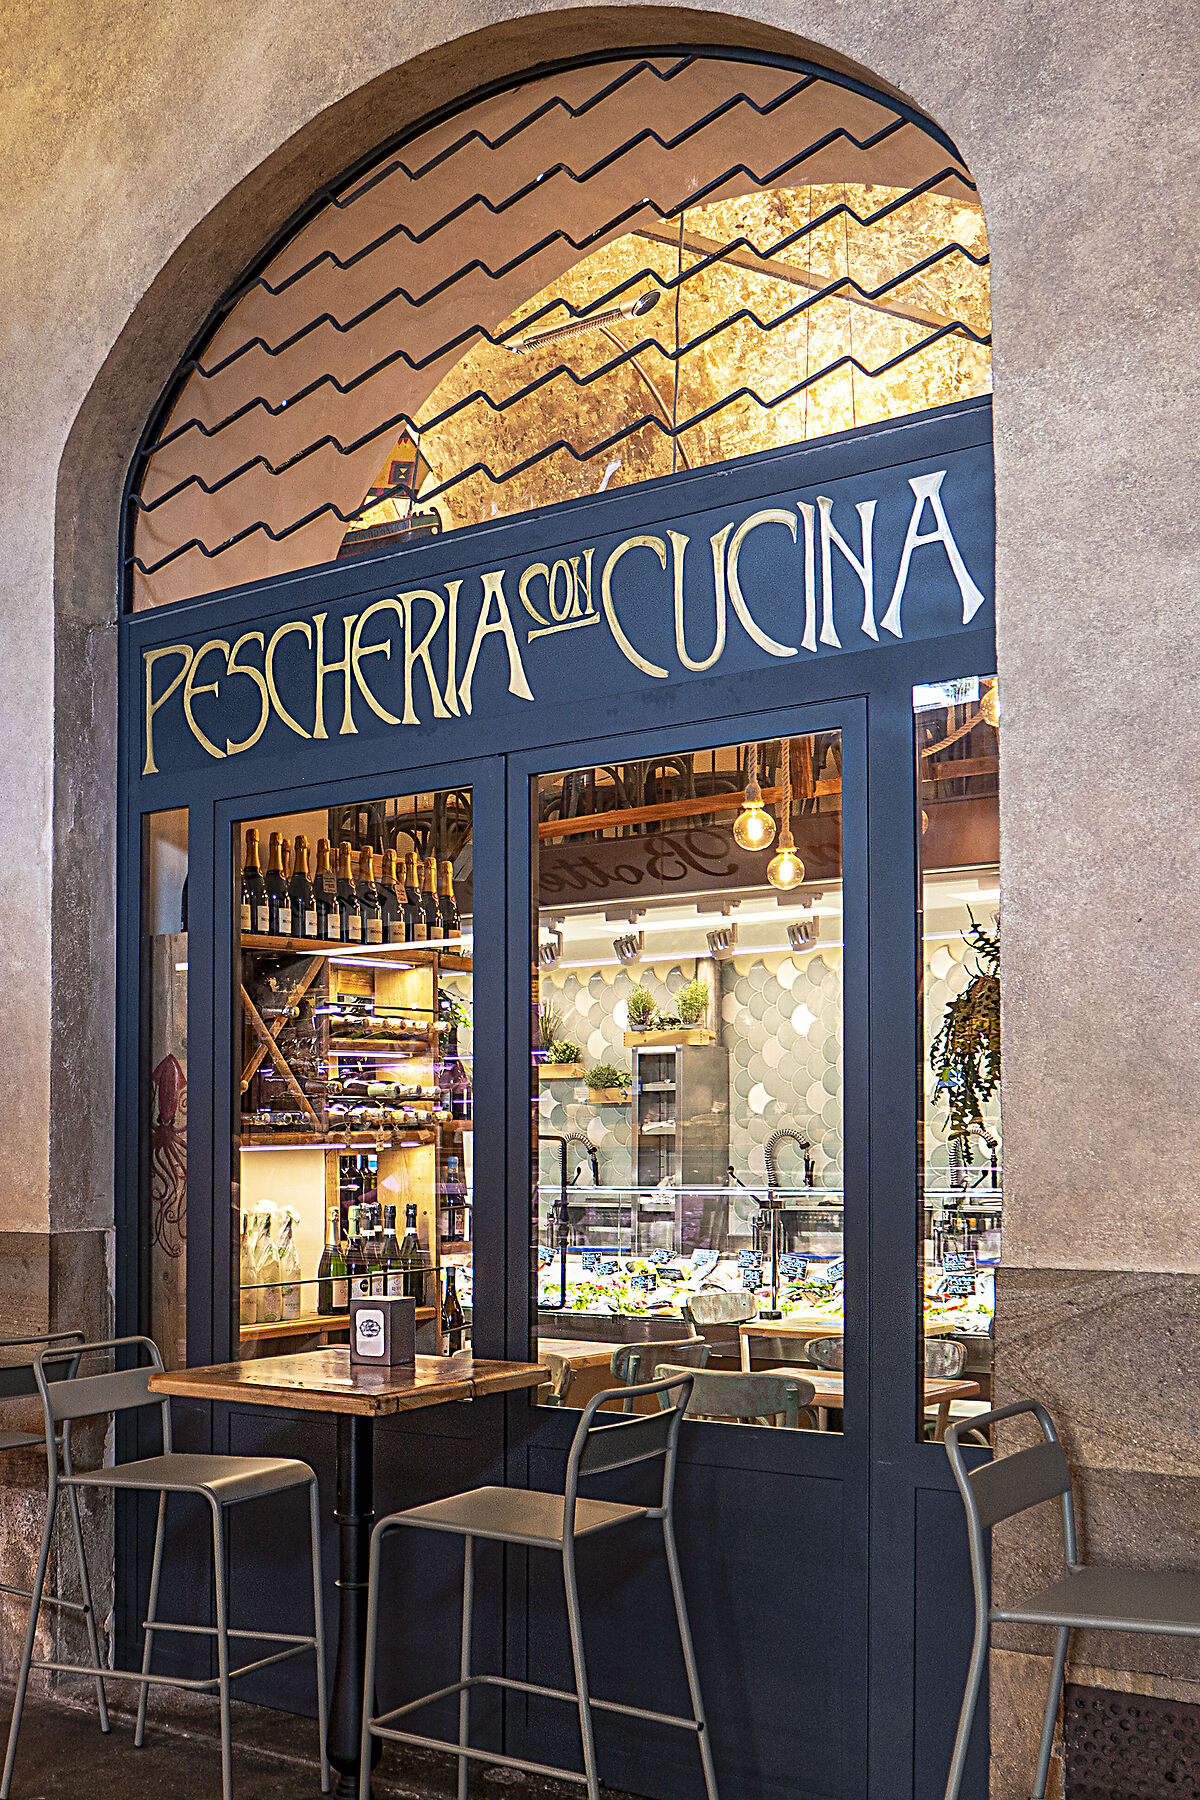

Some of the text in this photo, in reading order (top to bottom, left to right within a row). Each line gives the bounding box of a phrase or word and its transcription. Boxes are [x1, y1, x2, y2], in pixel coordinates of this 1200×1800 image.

[142, 470, 985, 776] PESCHERIA CON CUCINA
